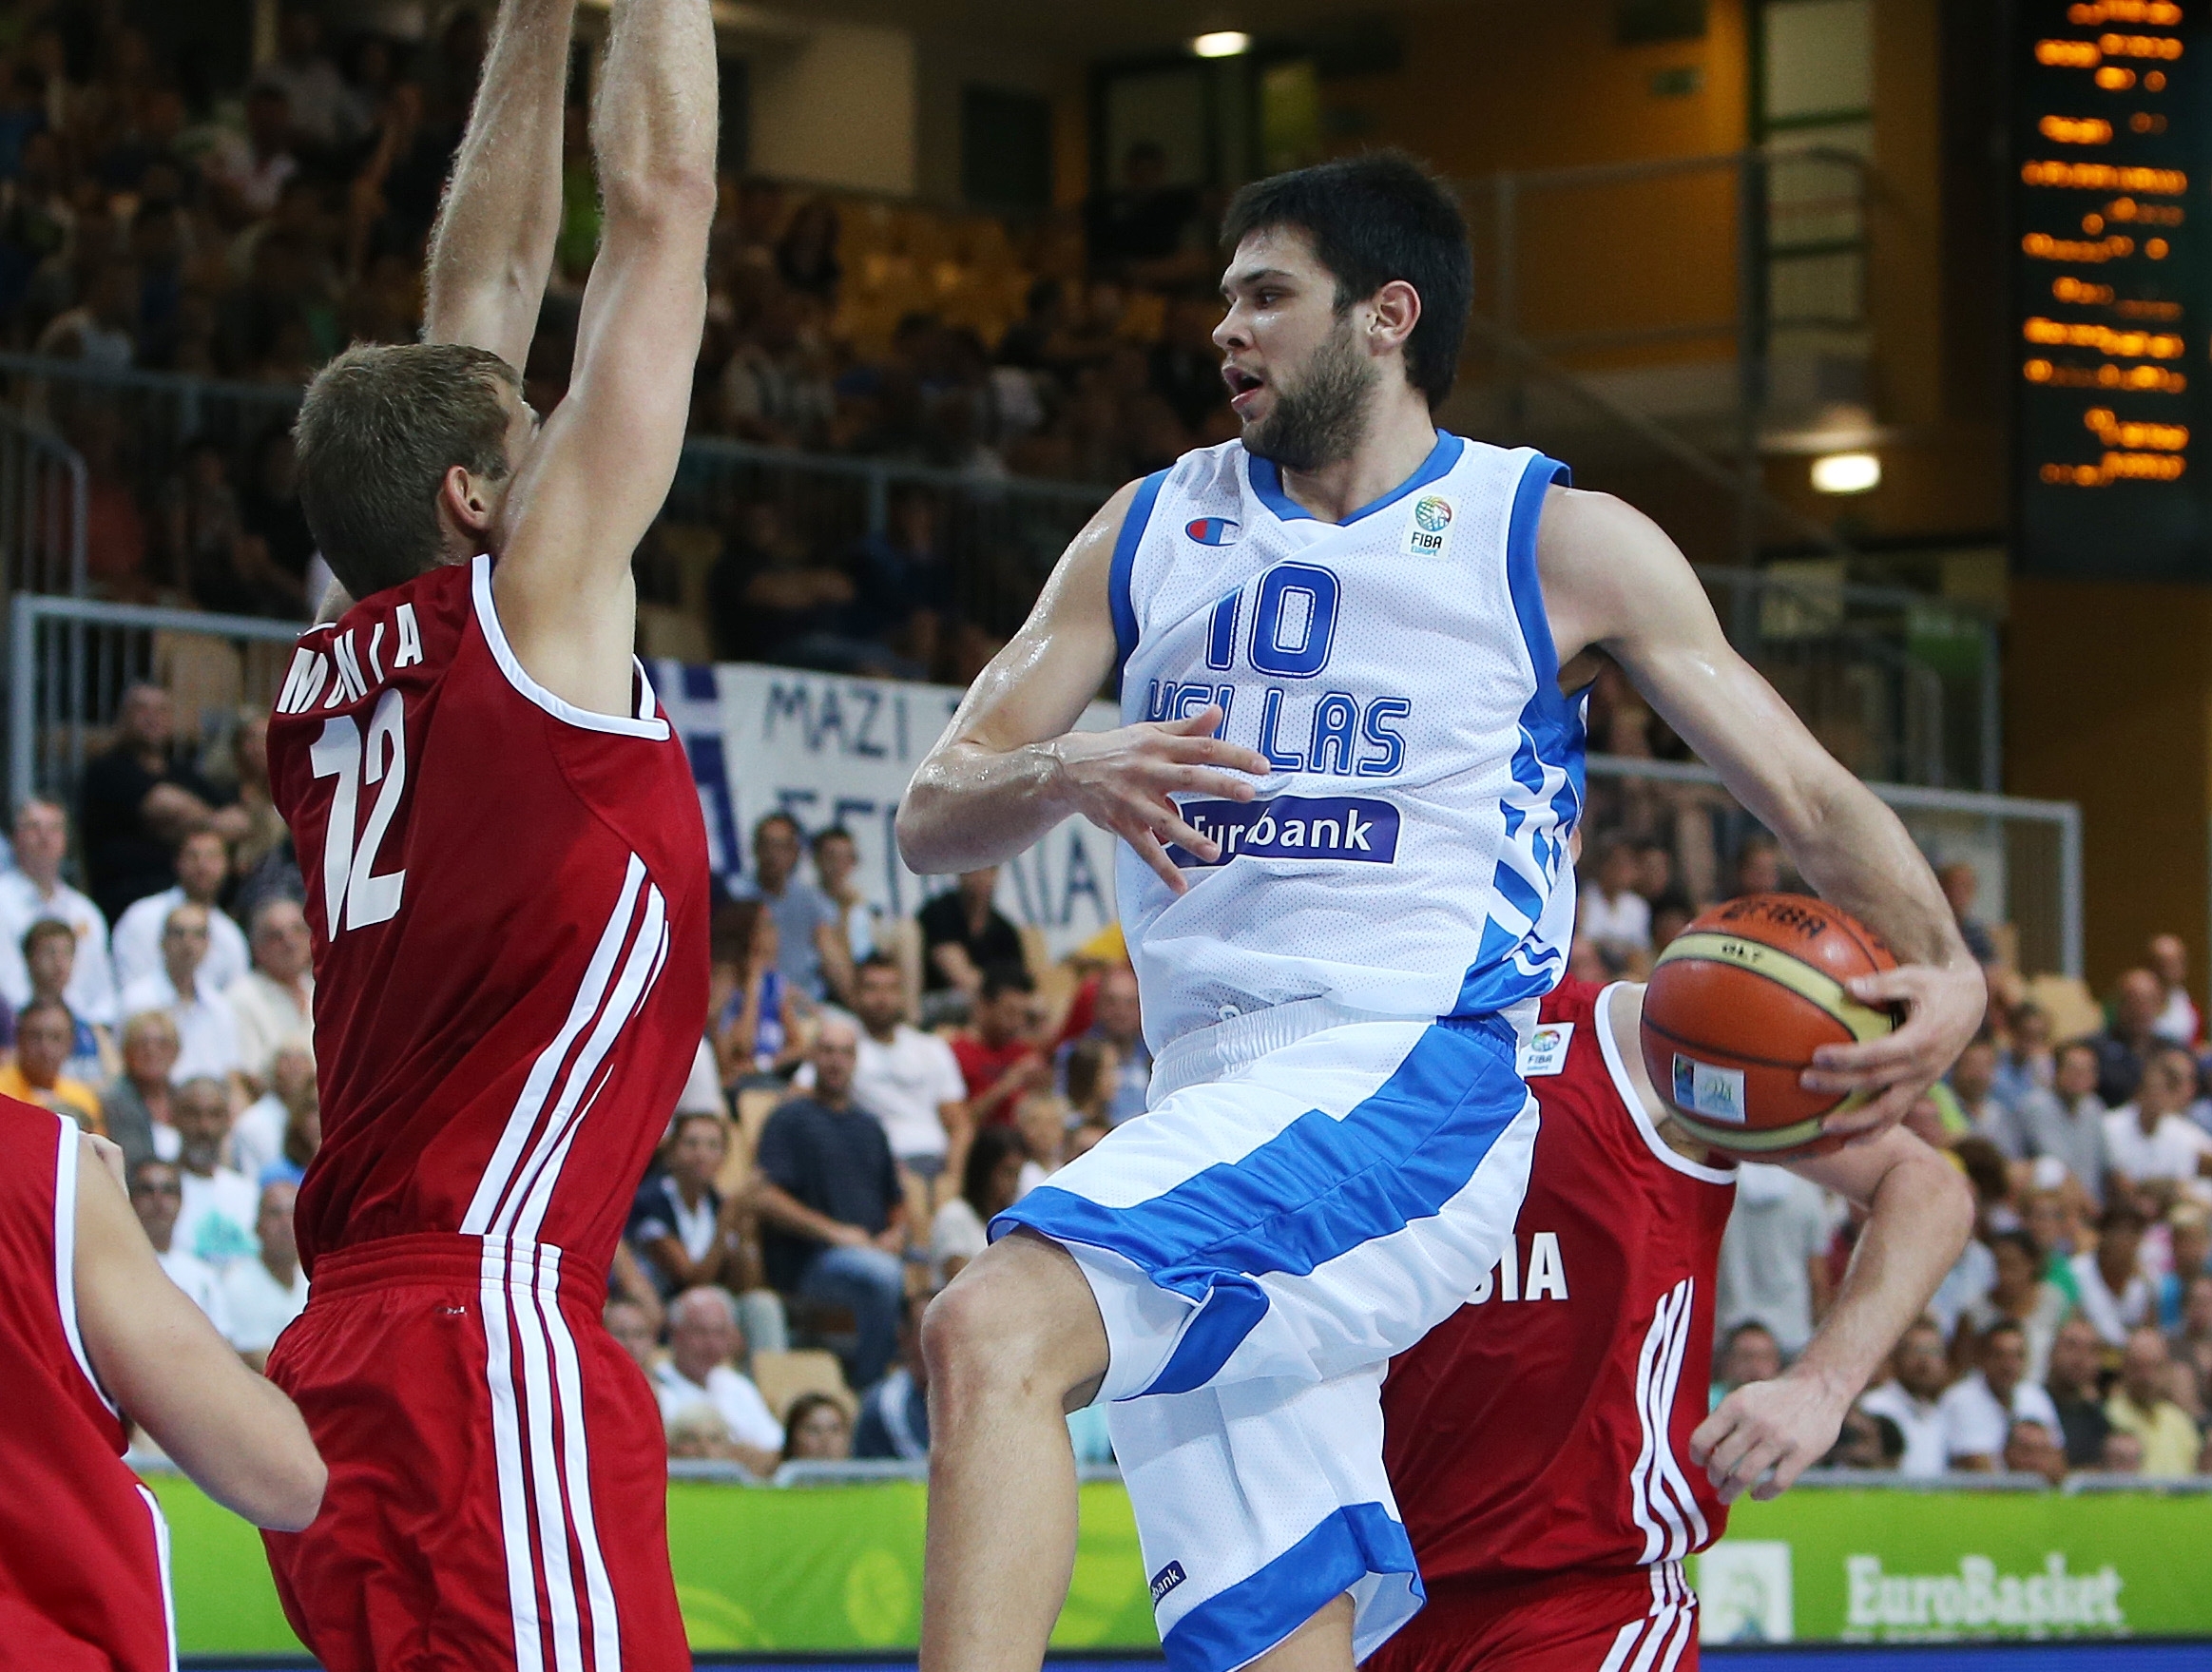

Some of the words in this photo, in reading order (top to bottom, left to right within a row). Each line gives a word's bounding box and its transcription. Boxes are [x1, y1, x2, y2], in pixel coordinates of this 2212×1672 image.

[1411, 531, 1443, 548] FIBA
[1205, 561, 1341, 679] 10
[310, 687, 409, 943] 12
[1846, 1552, 2125, 1626] EuroBasket
